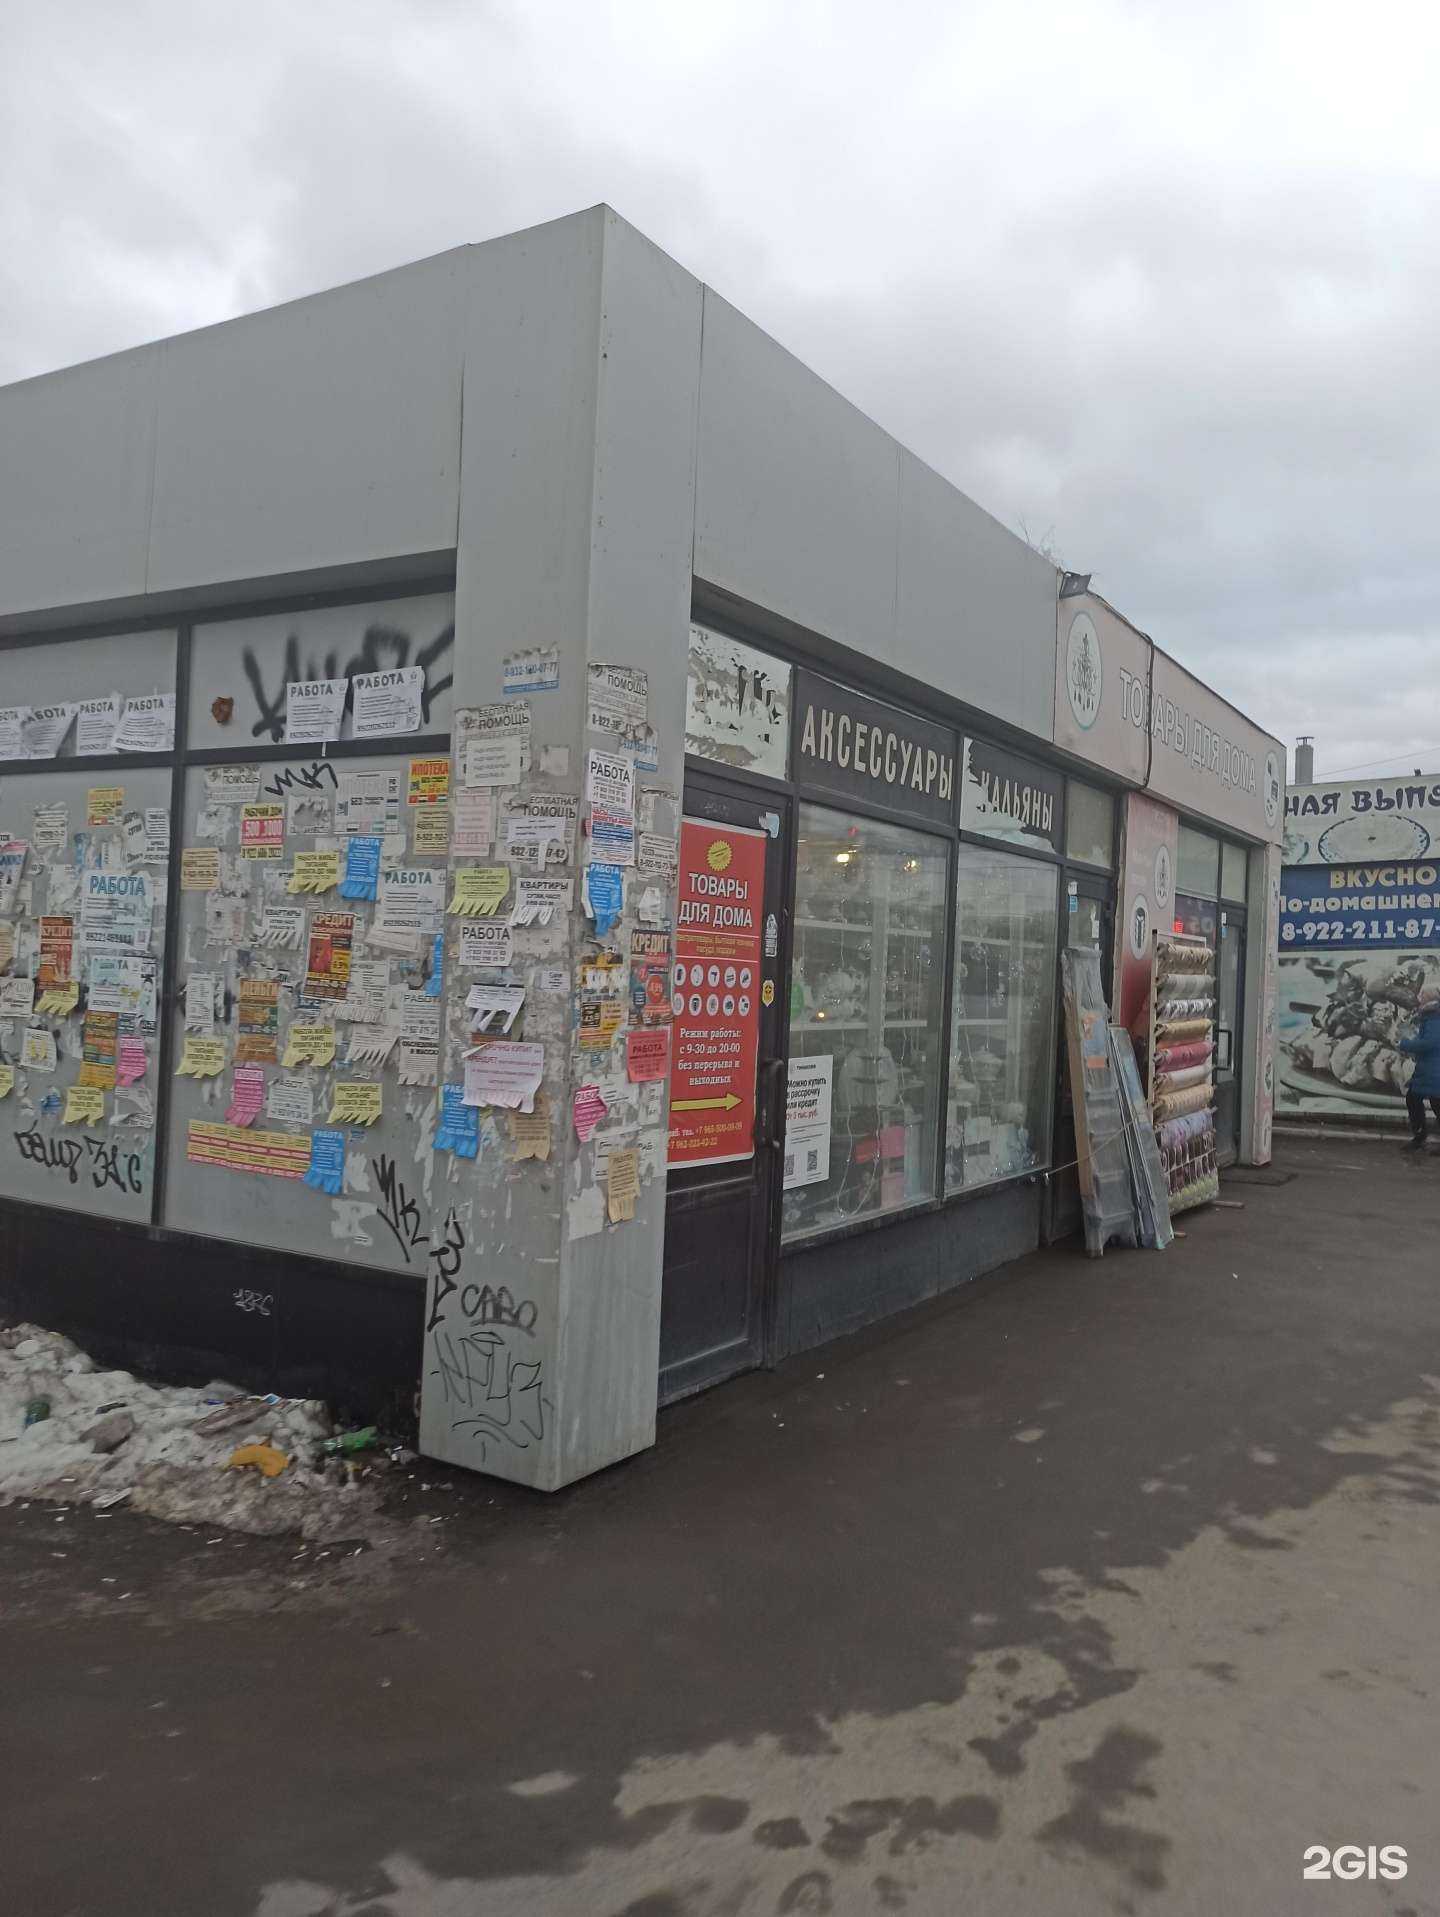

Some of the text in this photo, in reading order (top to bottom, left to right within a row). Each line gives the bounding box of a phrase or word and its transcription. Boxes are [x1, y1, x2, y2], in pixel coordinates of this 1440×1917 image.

[290, 683, 333, 697] РАБОТА
[356, 673, 405, 690] РАБОТА
[608, 674, 647, 696] ПОМОЩЬ
[80, 701, 114, 714] РАБОТА
[128, 699, 164, 712] РАБОТА
[480, 713, 529, 730] ПОМОЩЬ
[801, 704, 953, 801] АКСЕССУАРЫ
[1191, 719, 1221, 775] ДЛЯ
[1221, 740, 1257, 795] ДОМА
[591, 761, 631, 783] РАБОТА
[523, 806, 576, 819] ПОМОЩЬ
[90, 875, 146, 896] РАБОТА
[384, 871, 432, 884] РАБОТА
[520, 881, 568, 890] КВАРТИРЫ
[1330, 865, 1437, 889] ВКУСНО
[688, 872, 748, 900] ТОВАРЫ
[679, 900, 753, 928] ДЛЯ ДОМА
[463, 926, 510, 940] РАБОТА
[631, 931, 669, 953] КРЕДИТ
[680, 1026, 742, 1040] Режим работы:
[686, 1043, 705, 1054] 9-30
[719, 1043, 741, 1053] 20-00
[678, 1060, 692, 1070] без
